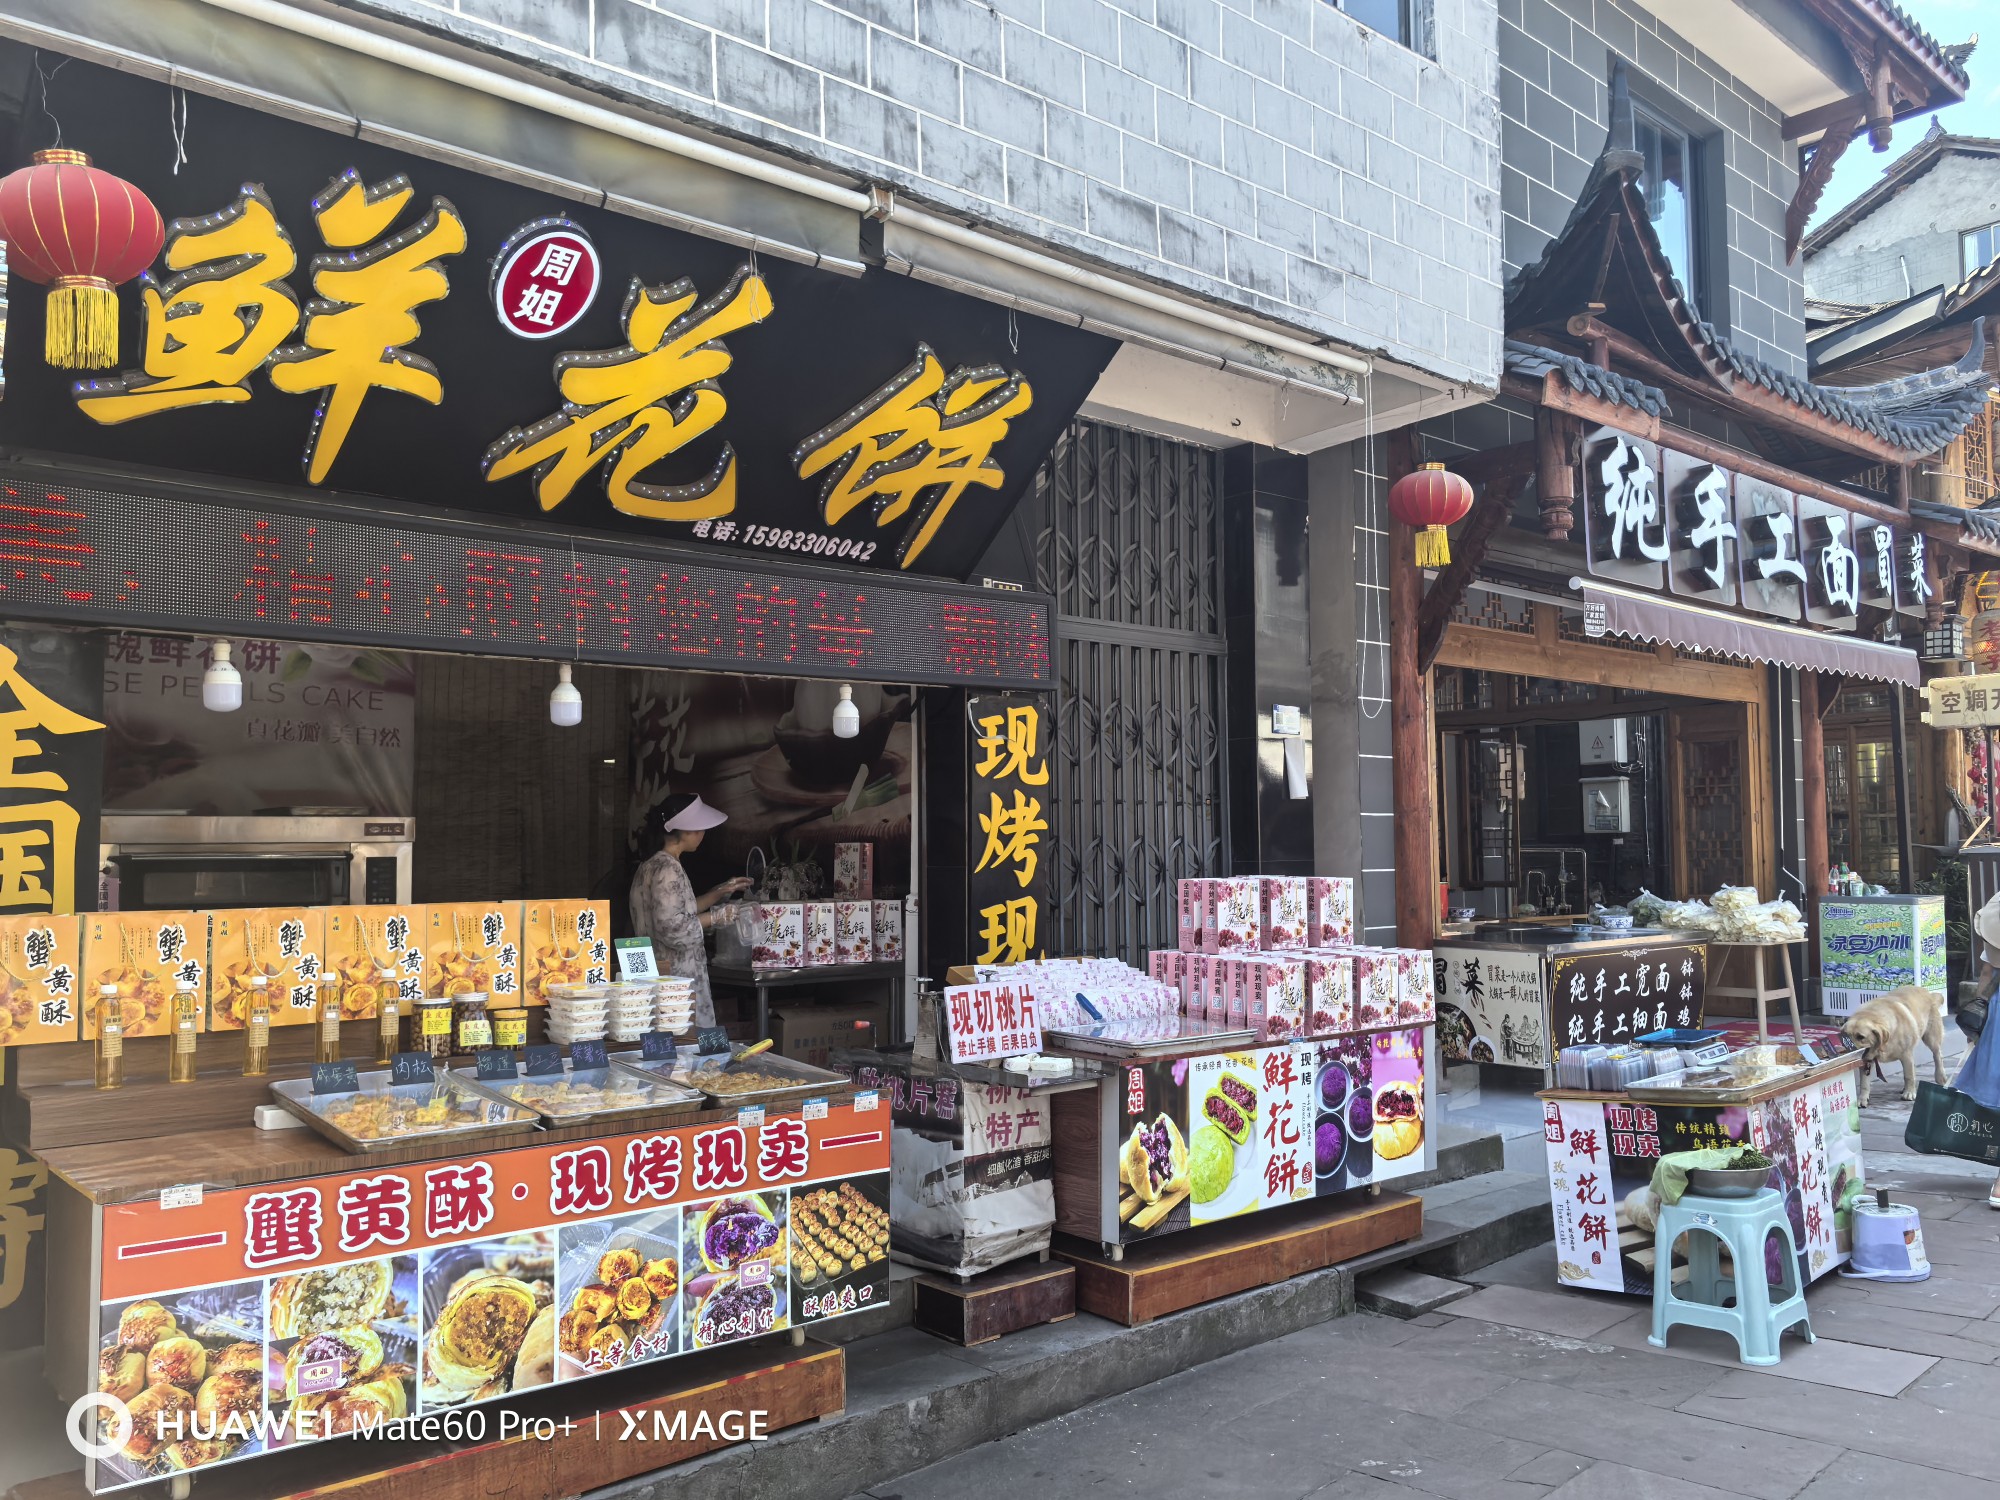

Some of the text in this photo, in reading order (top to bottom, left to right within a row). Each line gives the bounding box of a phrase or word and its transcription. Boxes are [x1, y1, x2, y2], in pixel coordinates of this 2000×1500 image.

[516, 241, 576, 328] 周姐
[76, 168, 1033, 571] 鲜花饼
[1600, 436, 1933, 615] 纯手工面 冒菜
[302, 685, 385, 711] CAKE
[280, 922, 319, 1007] 蟹黄酥
[483, 913, 518, 993] 蟹黄酥
[26, 929, 73, 1025] 蟹黄酥
[1487, 963, 1537, 985] 冒菜是一个人的火锅
[1488, 984, 1541, 1003] 火锅是一群人的冒菜
[1569, 962, 1671, 1004] 纯手工宽面
[1677, 957, 1695, 1028] 钵钵鸡
[950, 984, 1036, 1037] 现切桃片
[1567, 1001, 1668, 1046] 纯手工细面
[957, 1031, 1038, 1058] 禁止手摸 后果自负
[395, 1057, 434, 1080] 肉松
[1300, 1052, 1312, 1086] 现烤
[1127, 1067, 1145, 1115] 周姐
[985, 1108, 1040, 1149] 特产
[1544, 1103, 1562, 1142] 周姐
[1610, 1108, 1658, 1132] 现烤
[1675, 1121, 1731, 1137] 传统精致
[1613, 1133, 1661, 1158] 现卖
[1552, 1160, 1570, 1192] 玫瑰
[802, 1284, 873, 1318] 酥脆爽口
[696, 1309, 776, 1344] 精心制作
[583, 1330, 670, 1369] 上等食材
